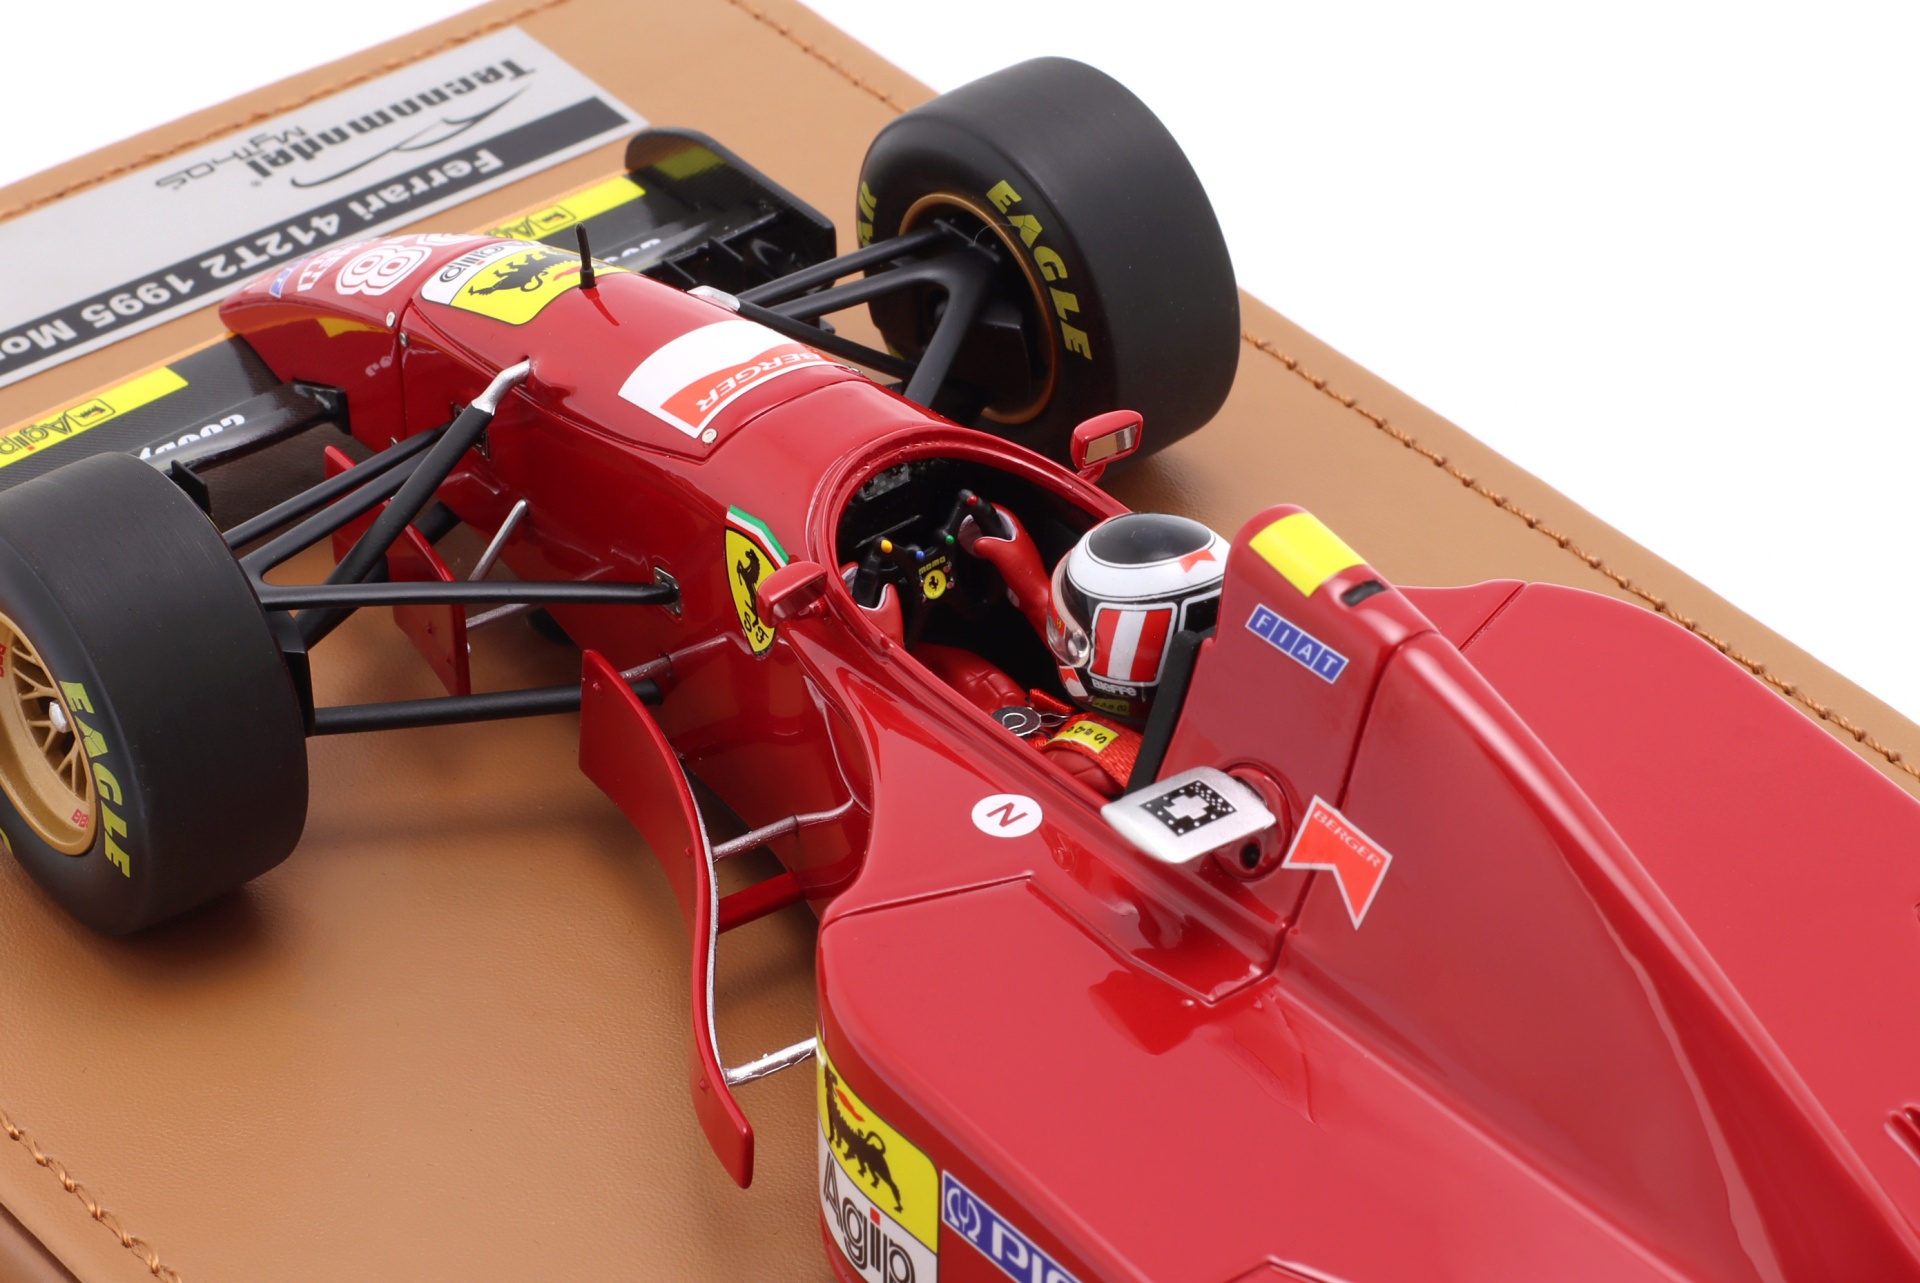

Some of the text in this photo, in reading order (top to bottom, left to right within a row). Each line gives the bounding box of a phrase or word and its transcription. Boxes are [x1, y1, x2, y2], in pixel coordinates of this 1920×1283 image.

[347, 147, 505, 219] Ferrari
[202, 210, 342, 279] 412T2
[985, 179, 1093, 361] EAGLE
[79, 272, 196, 330] 1995
[0, 318, 78, 366] Mo
[694, 352, 824, 413] BERGER
[1254, 611, 1339, 674] FIAT
[59, 680, 131, 879] EAGLE
[71, 808, 90, 829] BB
[985, 801, 1028, 828] N
[1312, 809, 1384, 869] BERGER
[823, 1149, 917, 1283] Agip
